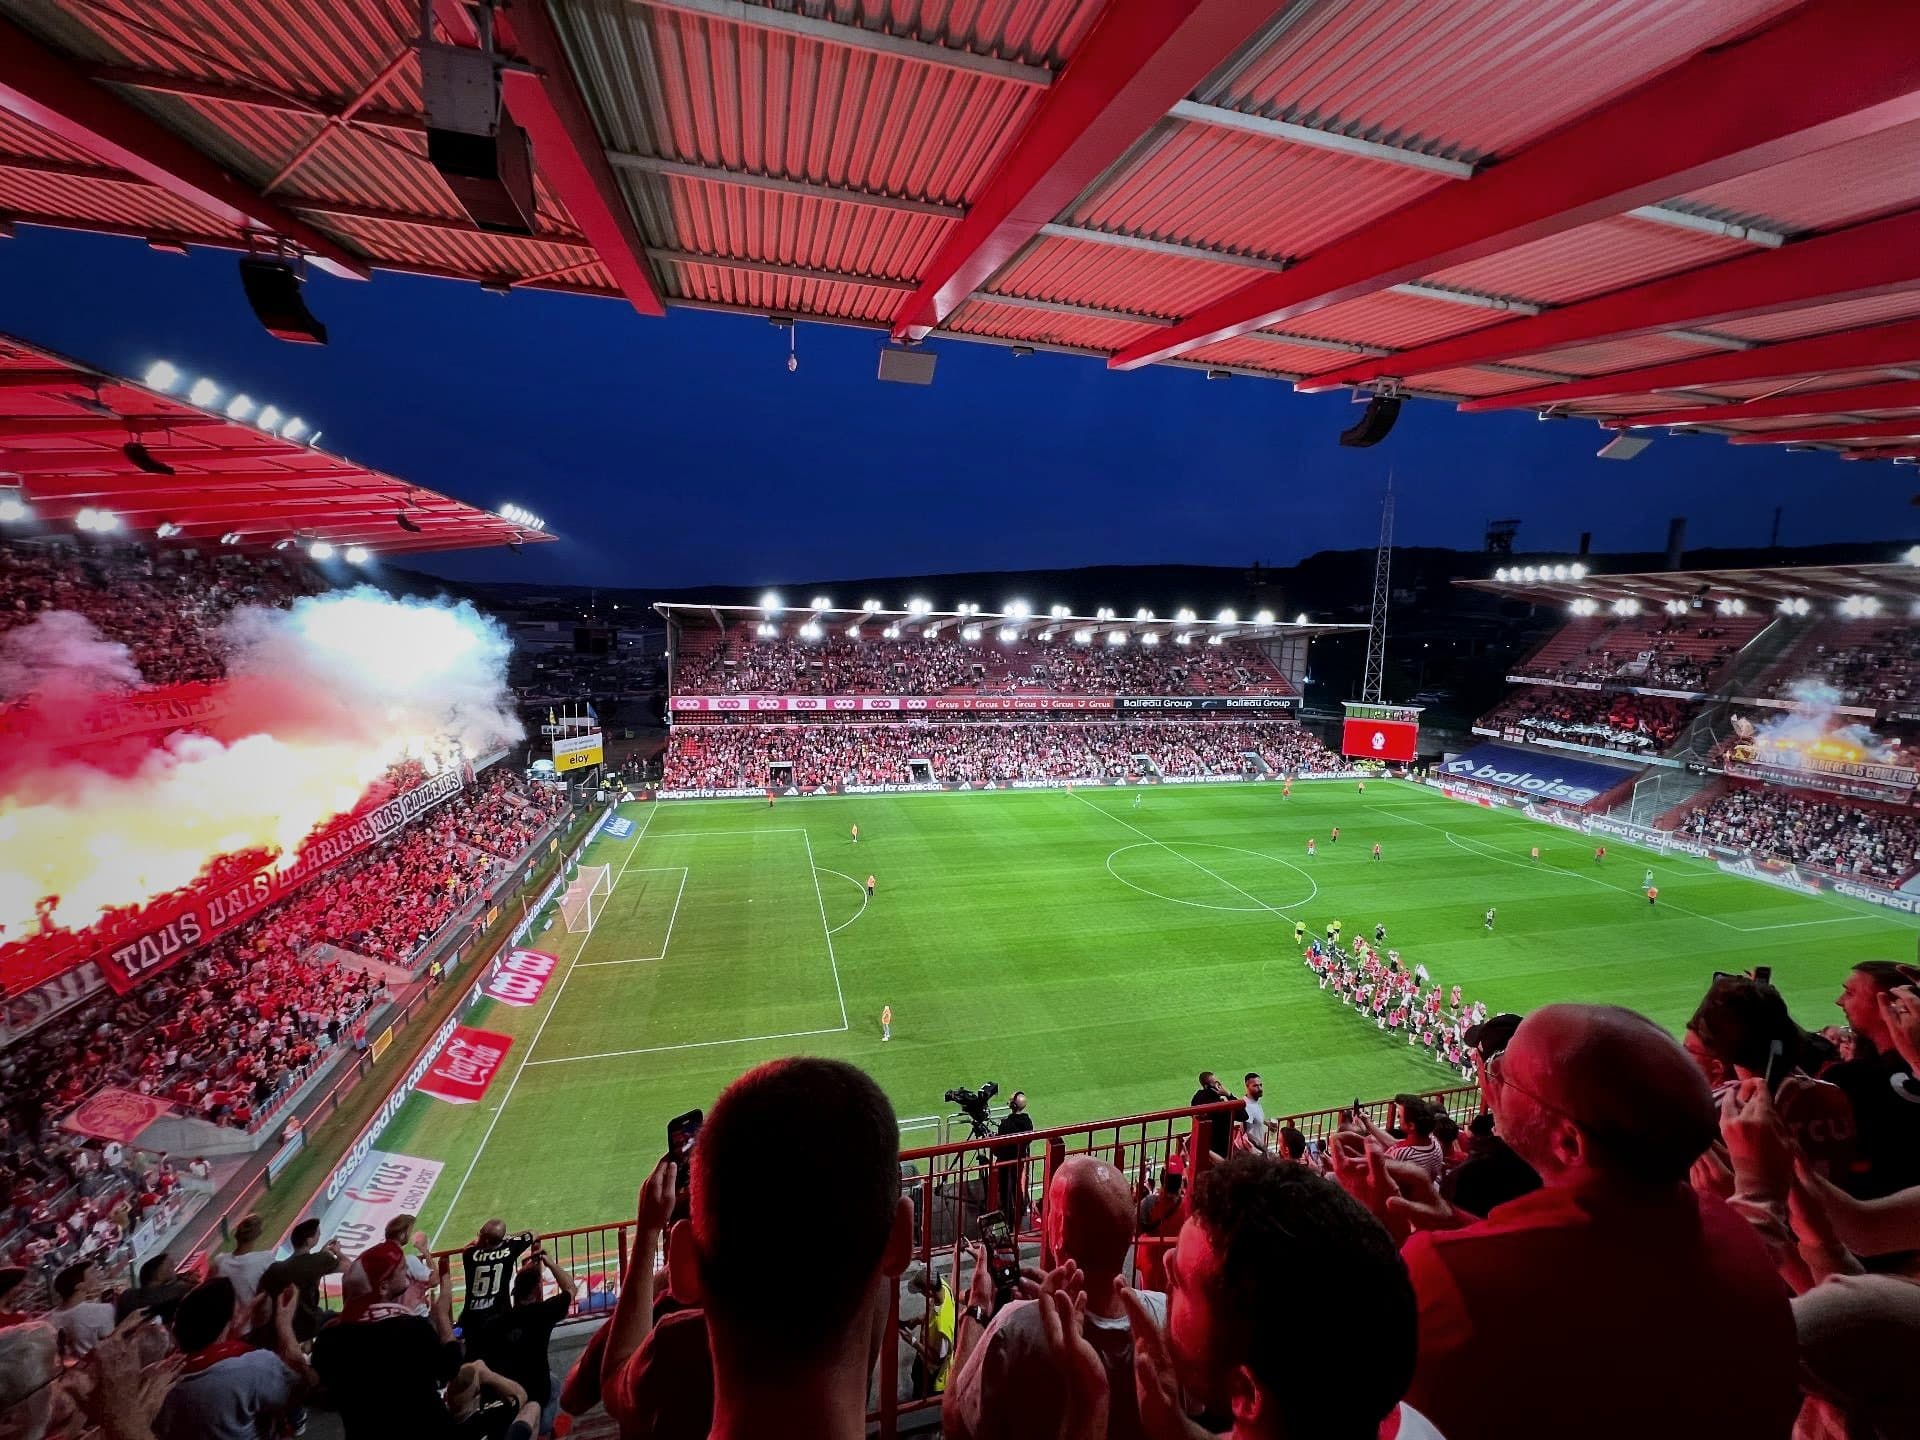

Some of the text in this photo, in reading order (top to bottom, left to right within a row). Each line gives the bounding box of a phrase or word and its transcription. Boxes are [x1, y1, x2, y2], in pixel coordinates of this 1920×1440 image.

[1163, 699, 1193, 709] Group
[1263, 699, 1291, 709] Group
[569, 753, 589, 765] eloy
[656, 786, 767, 799] designed for connection
[845, 782, 944, 793] designed for connection
[1471, 764, 1600, 802] baloise
[1466, 788, 1508, 805] connection
[1628, 826, 1646, 840] for
[1645, 832, 1710, 858] connection
[111, 912, 202, 978] TOUS
[207, 872, 271, 927] UNIS
[374, 801, 404, 832] NOS
[402, 771, 461, 815] COULEURS
[1833, 881, 1914, 912] designed
[327, 1017, 459, 1201] designed for connection
[343, 1161, 413, 1204] Circus
[472, 1247, 511, 1262] Circus
[471, 1262, 504, 1297] 61
